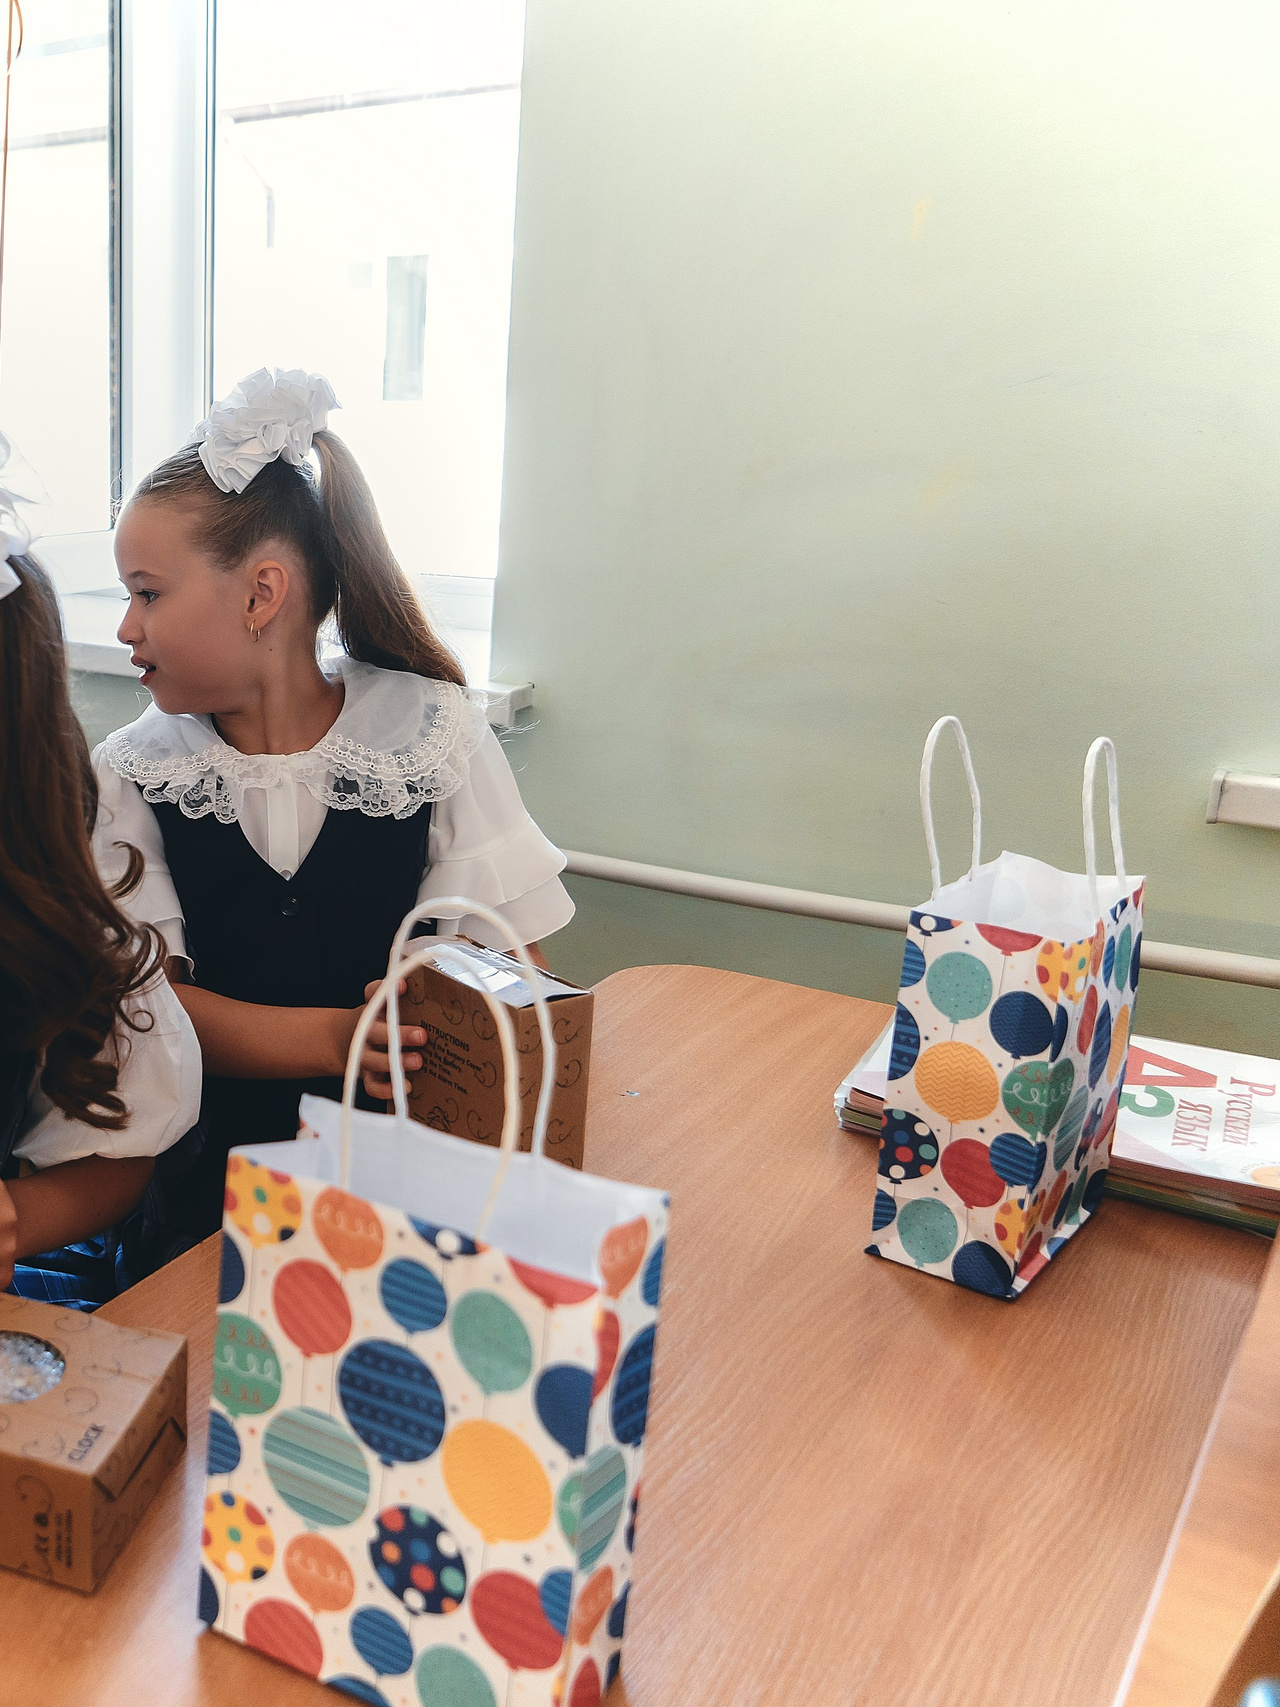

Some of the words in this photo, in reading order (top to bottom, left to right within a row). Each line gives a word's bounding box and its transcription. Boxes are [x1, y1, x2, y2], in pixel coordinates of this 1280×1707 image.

[420, 1019, 470, 1052] INSTRUCTIONS
[1217, 1076, 1276, 1147] Русский
[67, 1423, 104, 1461] CLOCK
